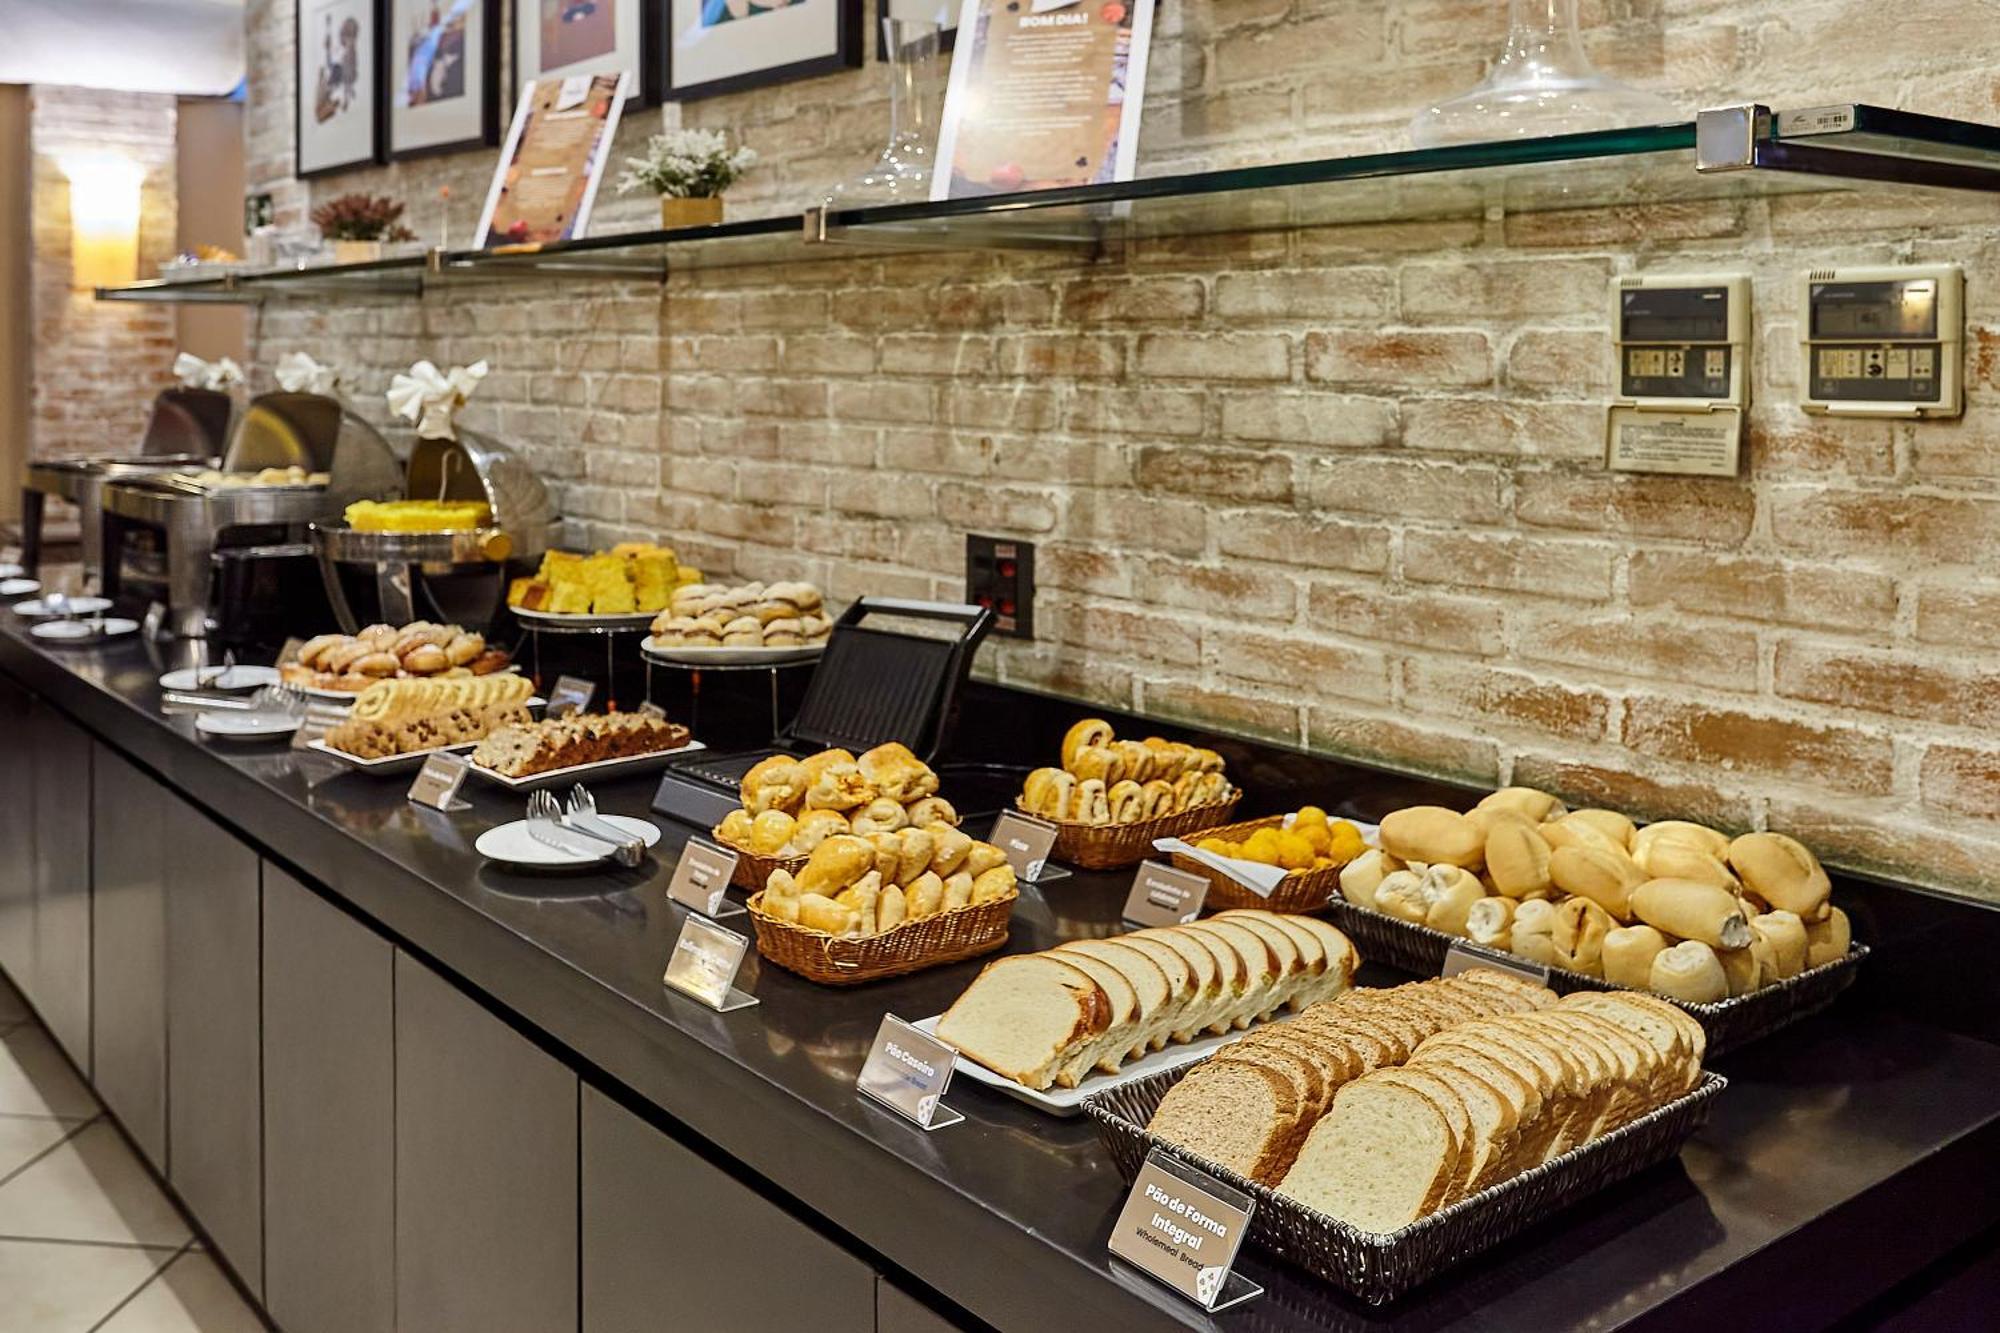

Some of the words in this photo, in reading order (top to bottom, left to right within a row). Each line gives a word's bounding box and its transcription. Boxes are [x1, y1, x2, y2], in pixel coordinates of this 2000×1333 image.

[1019, 14, 1055, 28] BOM
[885, 1042, 902, 1059] Pão
[902, 1051, 935, 1077] Caseiro
[1144, 1183, 1168, 1207] Pão
[1168, 1197, 1185, 1214] de
[1185, 1206, 1228, 1238] Forma
[1136, 1227, 1180, 1257] Wholemeal
[1179, 1252, 1205, 1272] Bread
[1151, 1213, 1204, 1250] Integral
